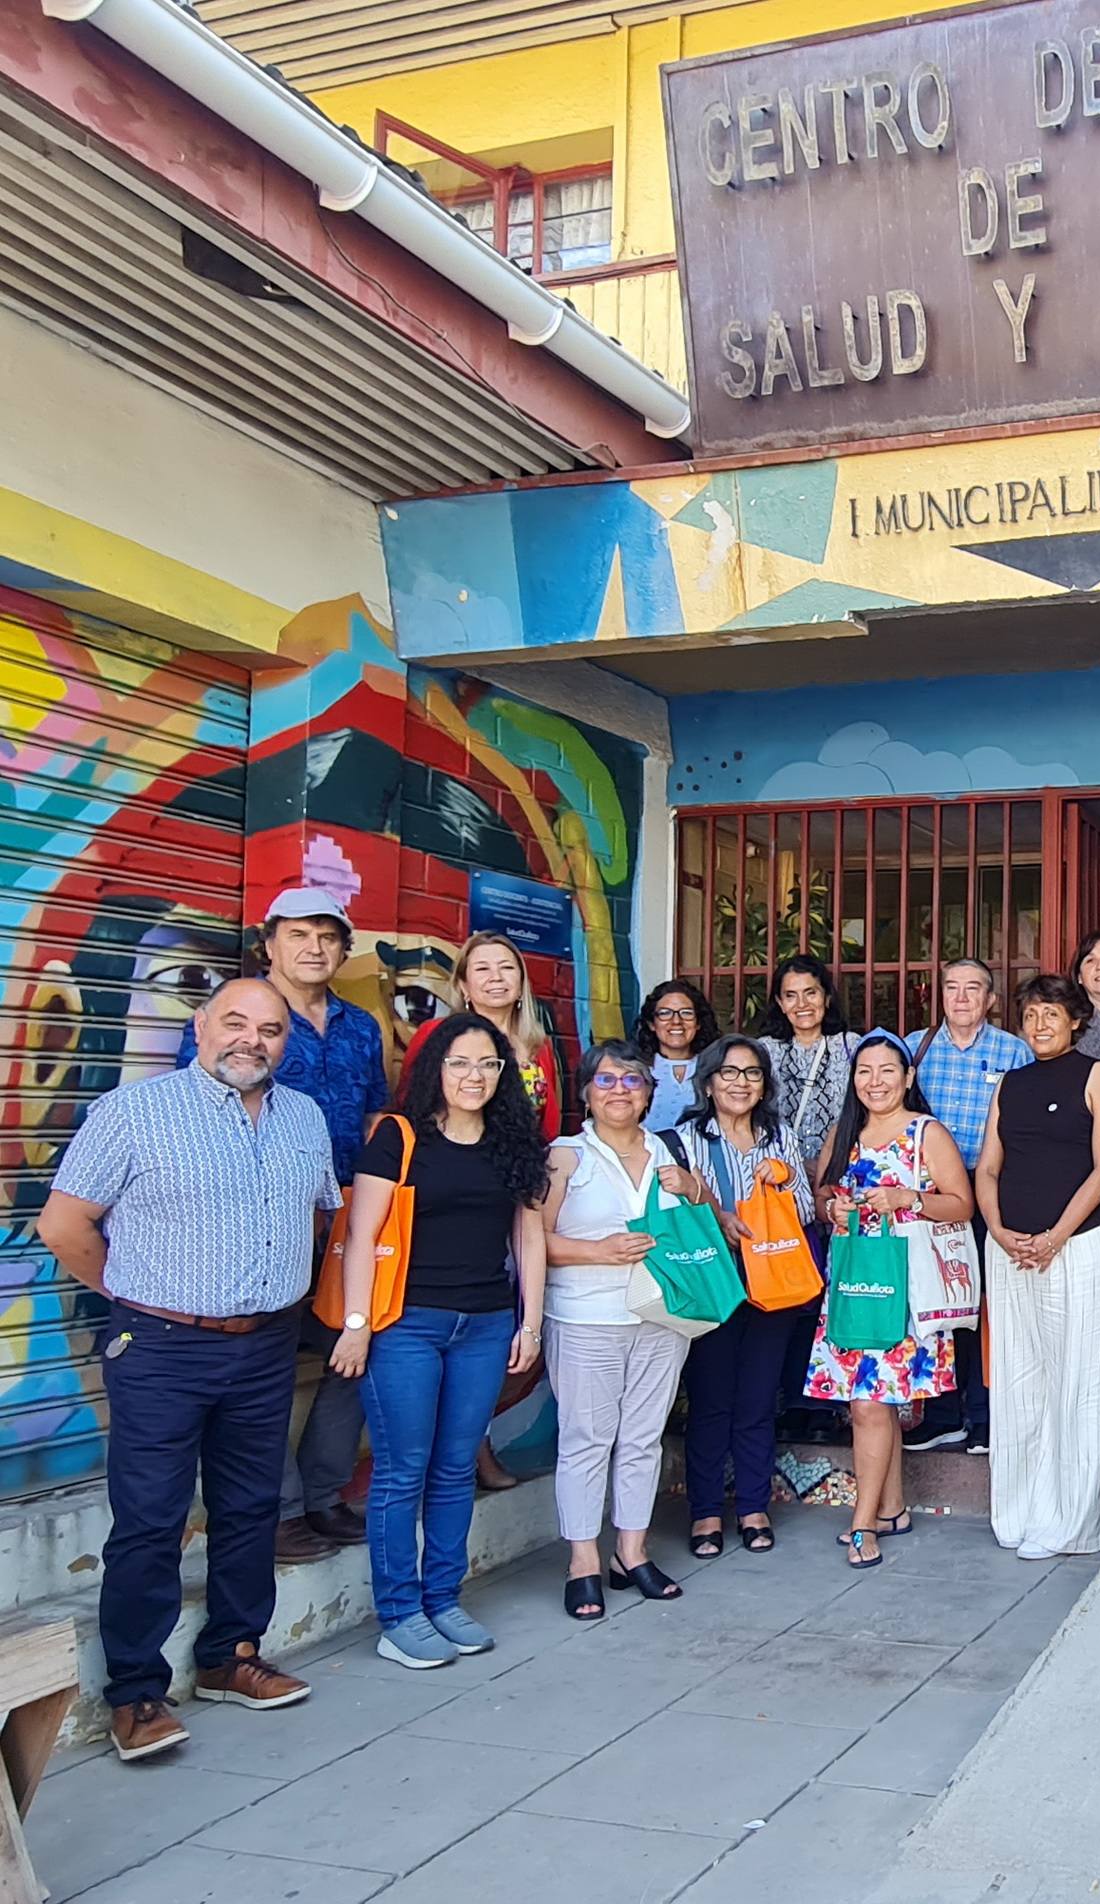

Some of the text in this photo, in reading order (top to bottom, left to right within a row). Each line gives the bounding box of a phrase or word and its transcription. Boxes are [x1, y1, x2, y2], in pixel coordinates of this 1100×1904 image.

[700, 61, 951, 187] CENTRO
[959, 157, 1047, 256] DE
[721, 289, 927, 400] SALUD
[993, 273, 1036, 363] Y
